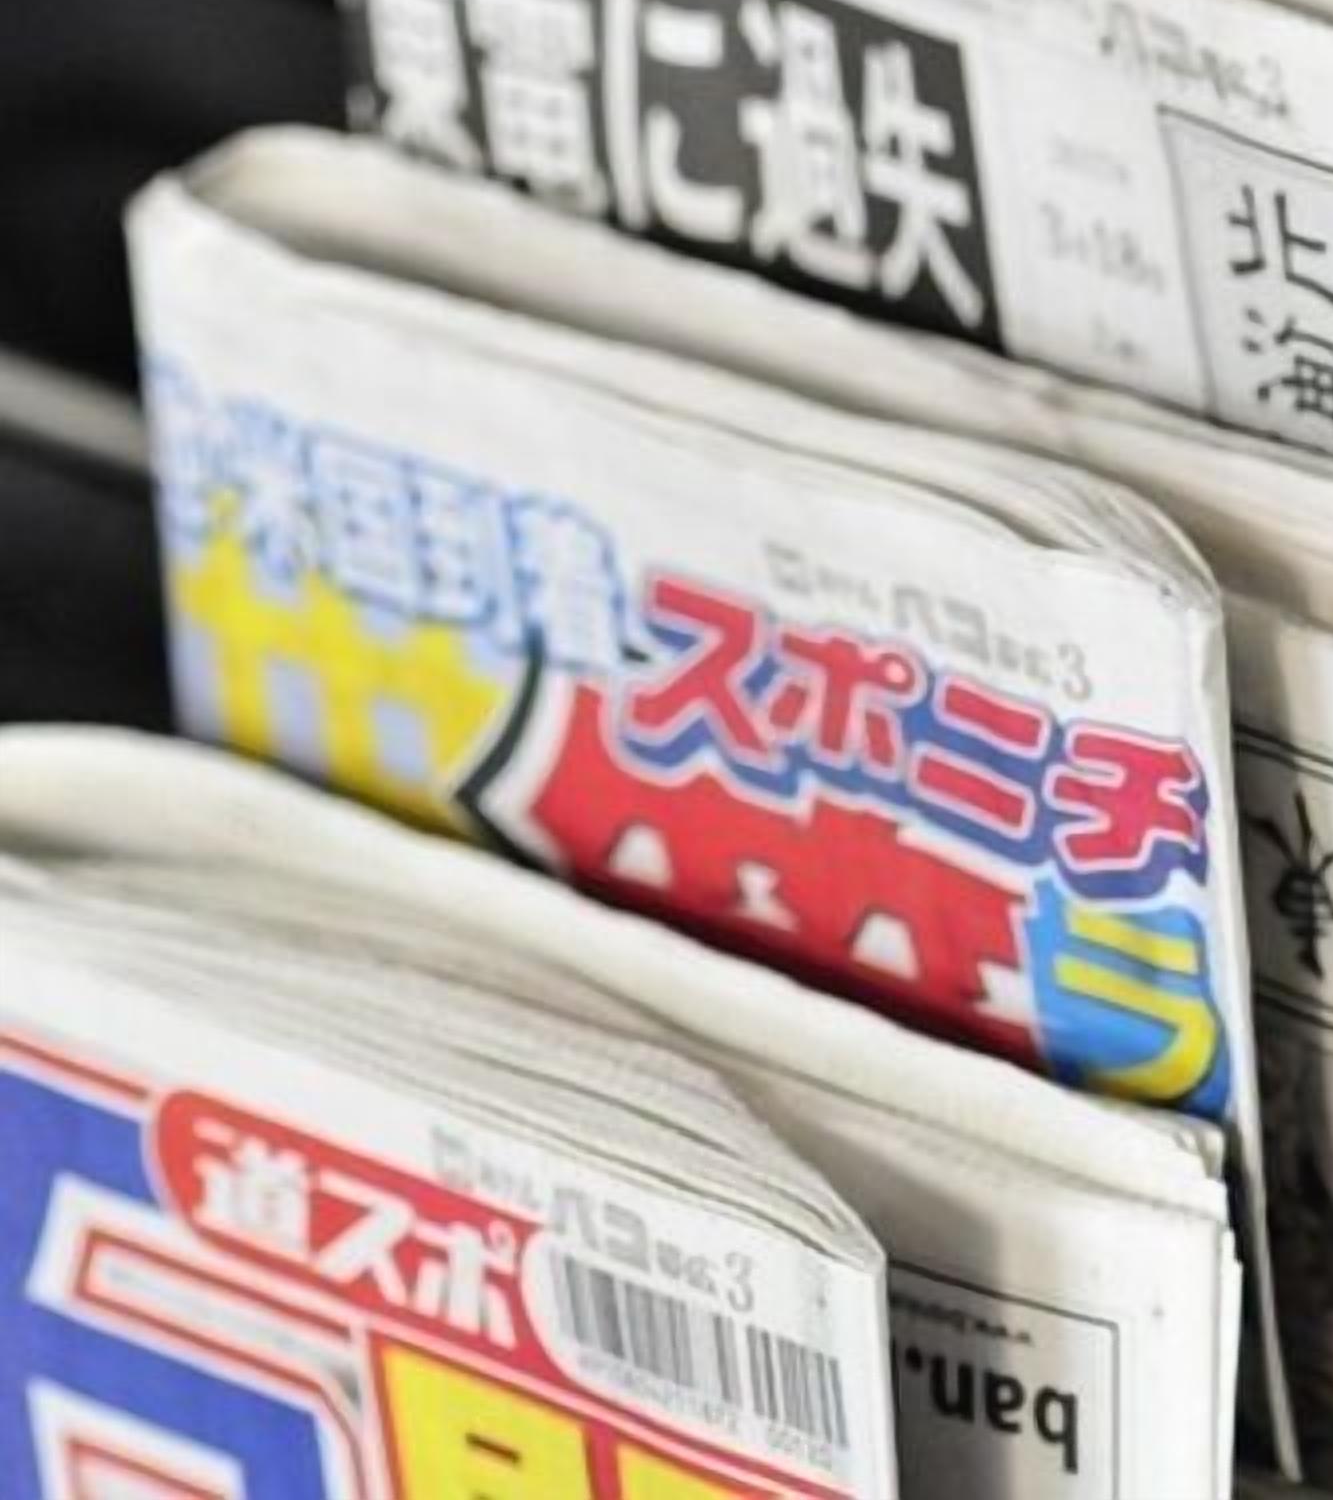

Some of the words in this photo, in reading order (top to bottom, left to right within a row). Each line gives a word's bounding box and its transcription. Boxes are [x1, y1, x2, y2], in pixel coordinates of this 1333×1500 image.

[622, 575, 1203, 878] スポニチ
[192, 1112, 522, 1352] 道スポ
